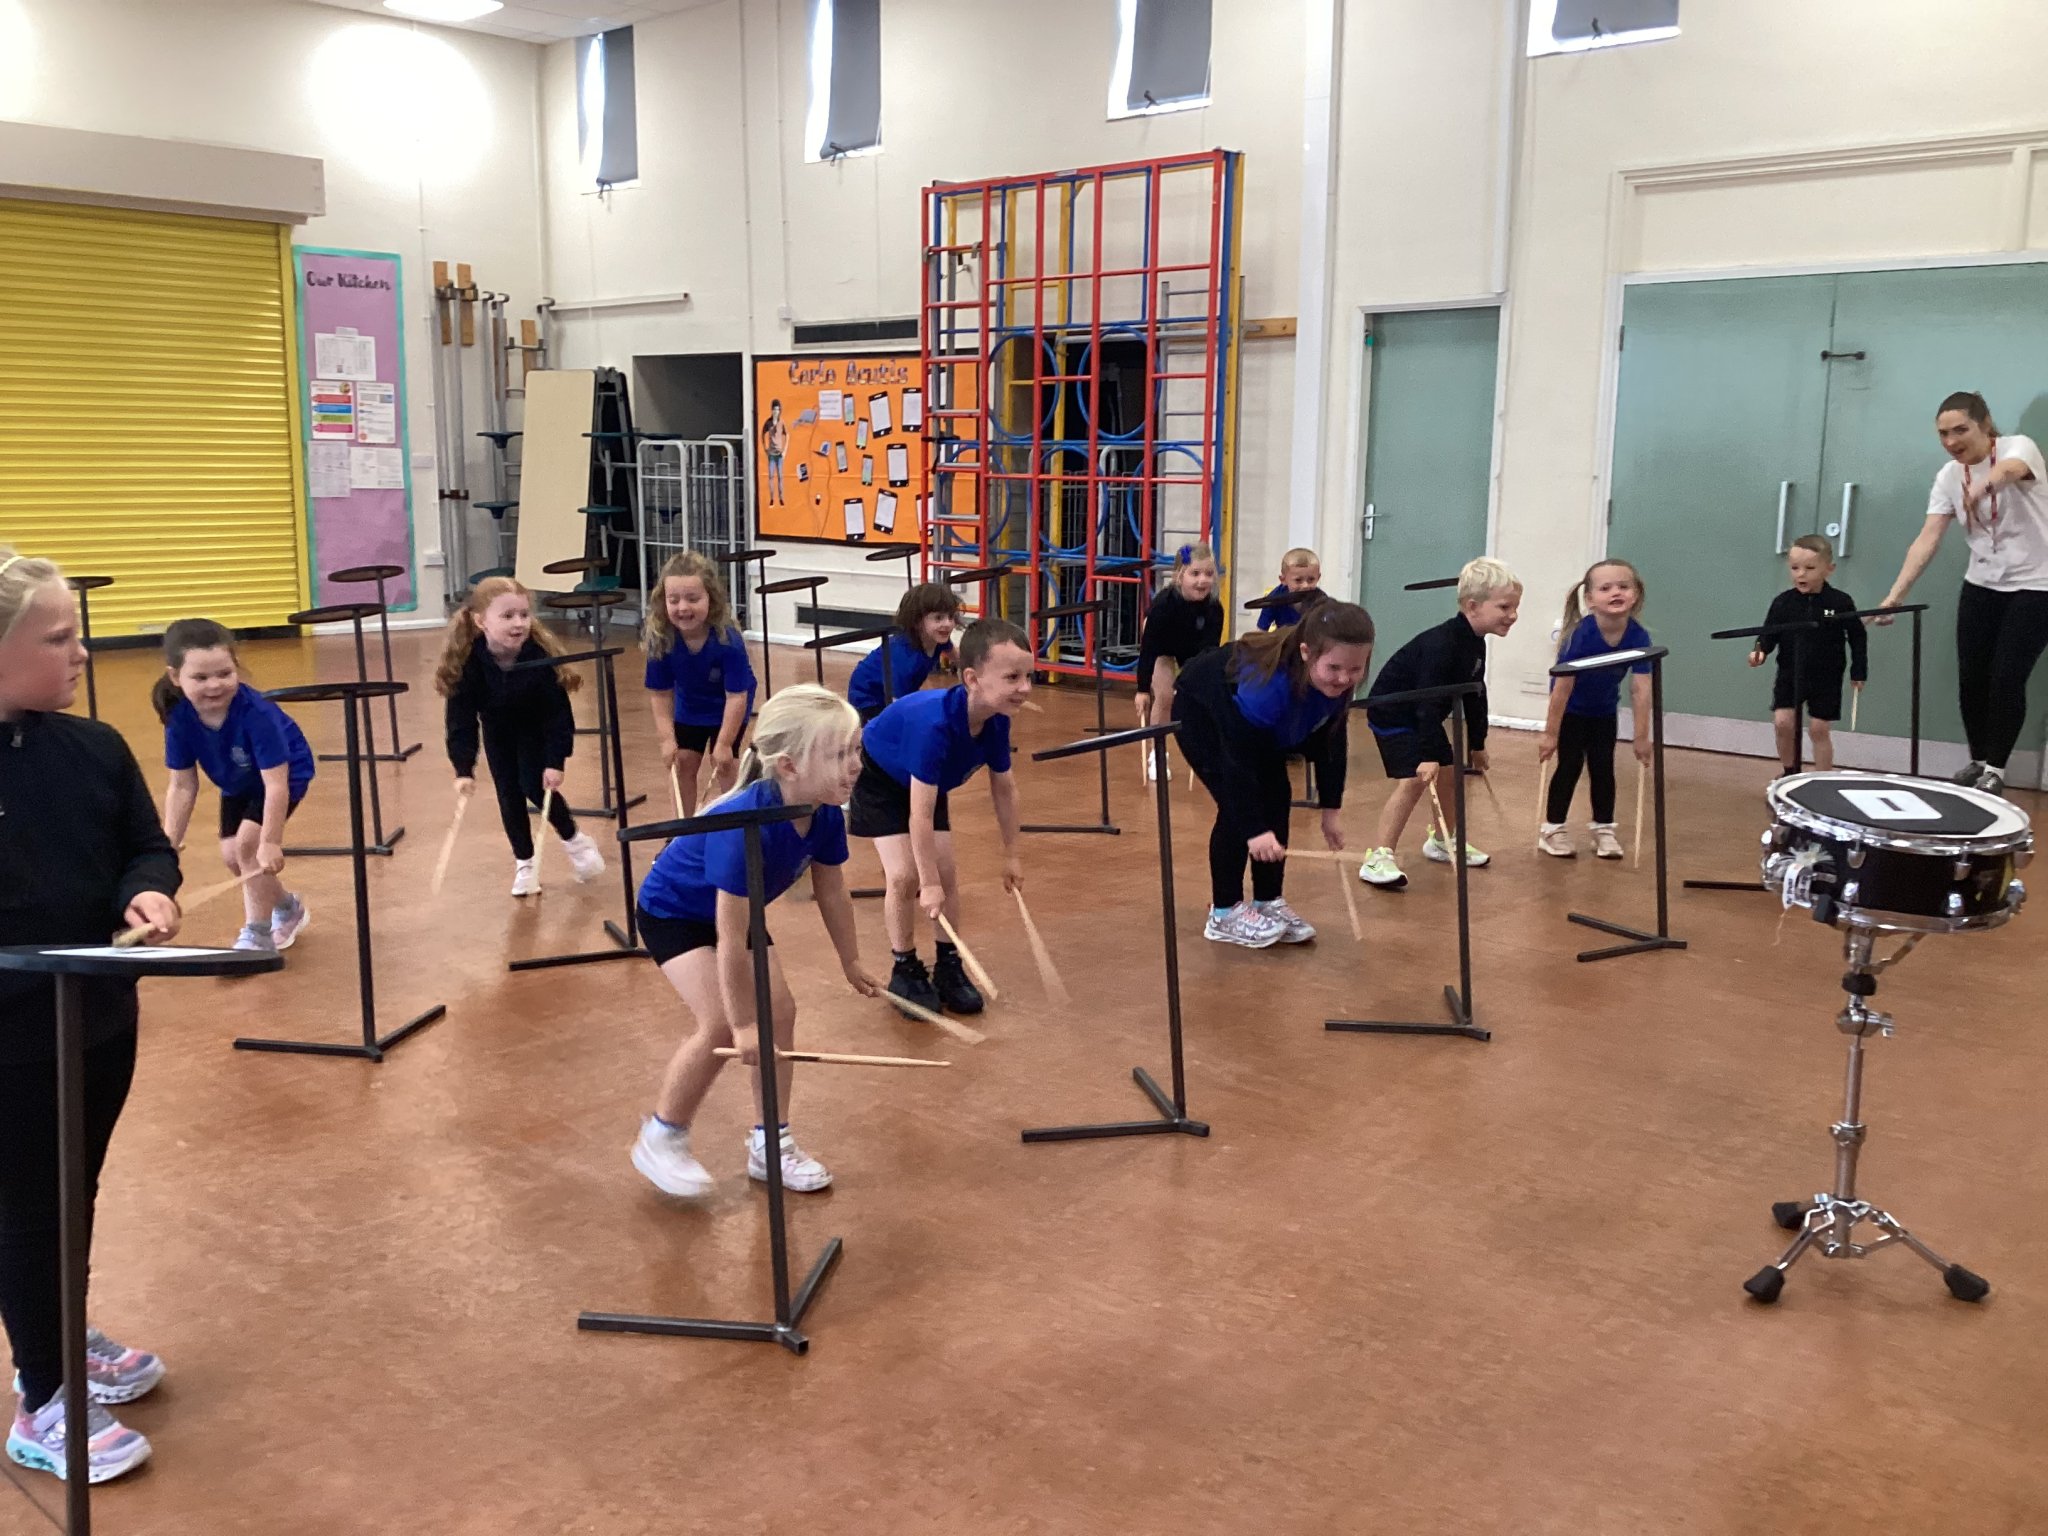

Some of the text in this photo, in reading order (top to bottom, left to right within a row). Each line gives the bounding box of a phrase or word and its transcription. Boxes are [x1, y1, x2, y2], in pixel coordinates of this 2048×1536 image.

[306, 271, 391, 290] Our Kitchen
[788, 357, 908, 385] Carlo Acutis
